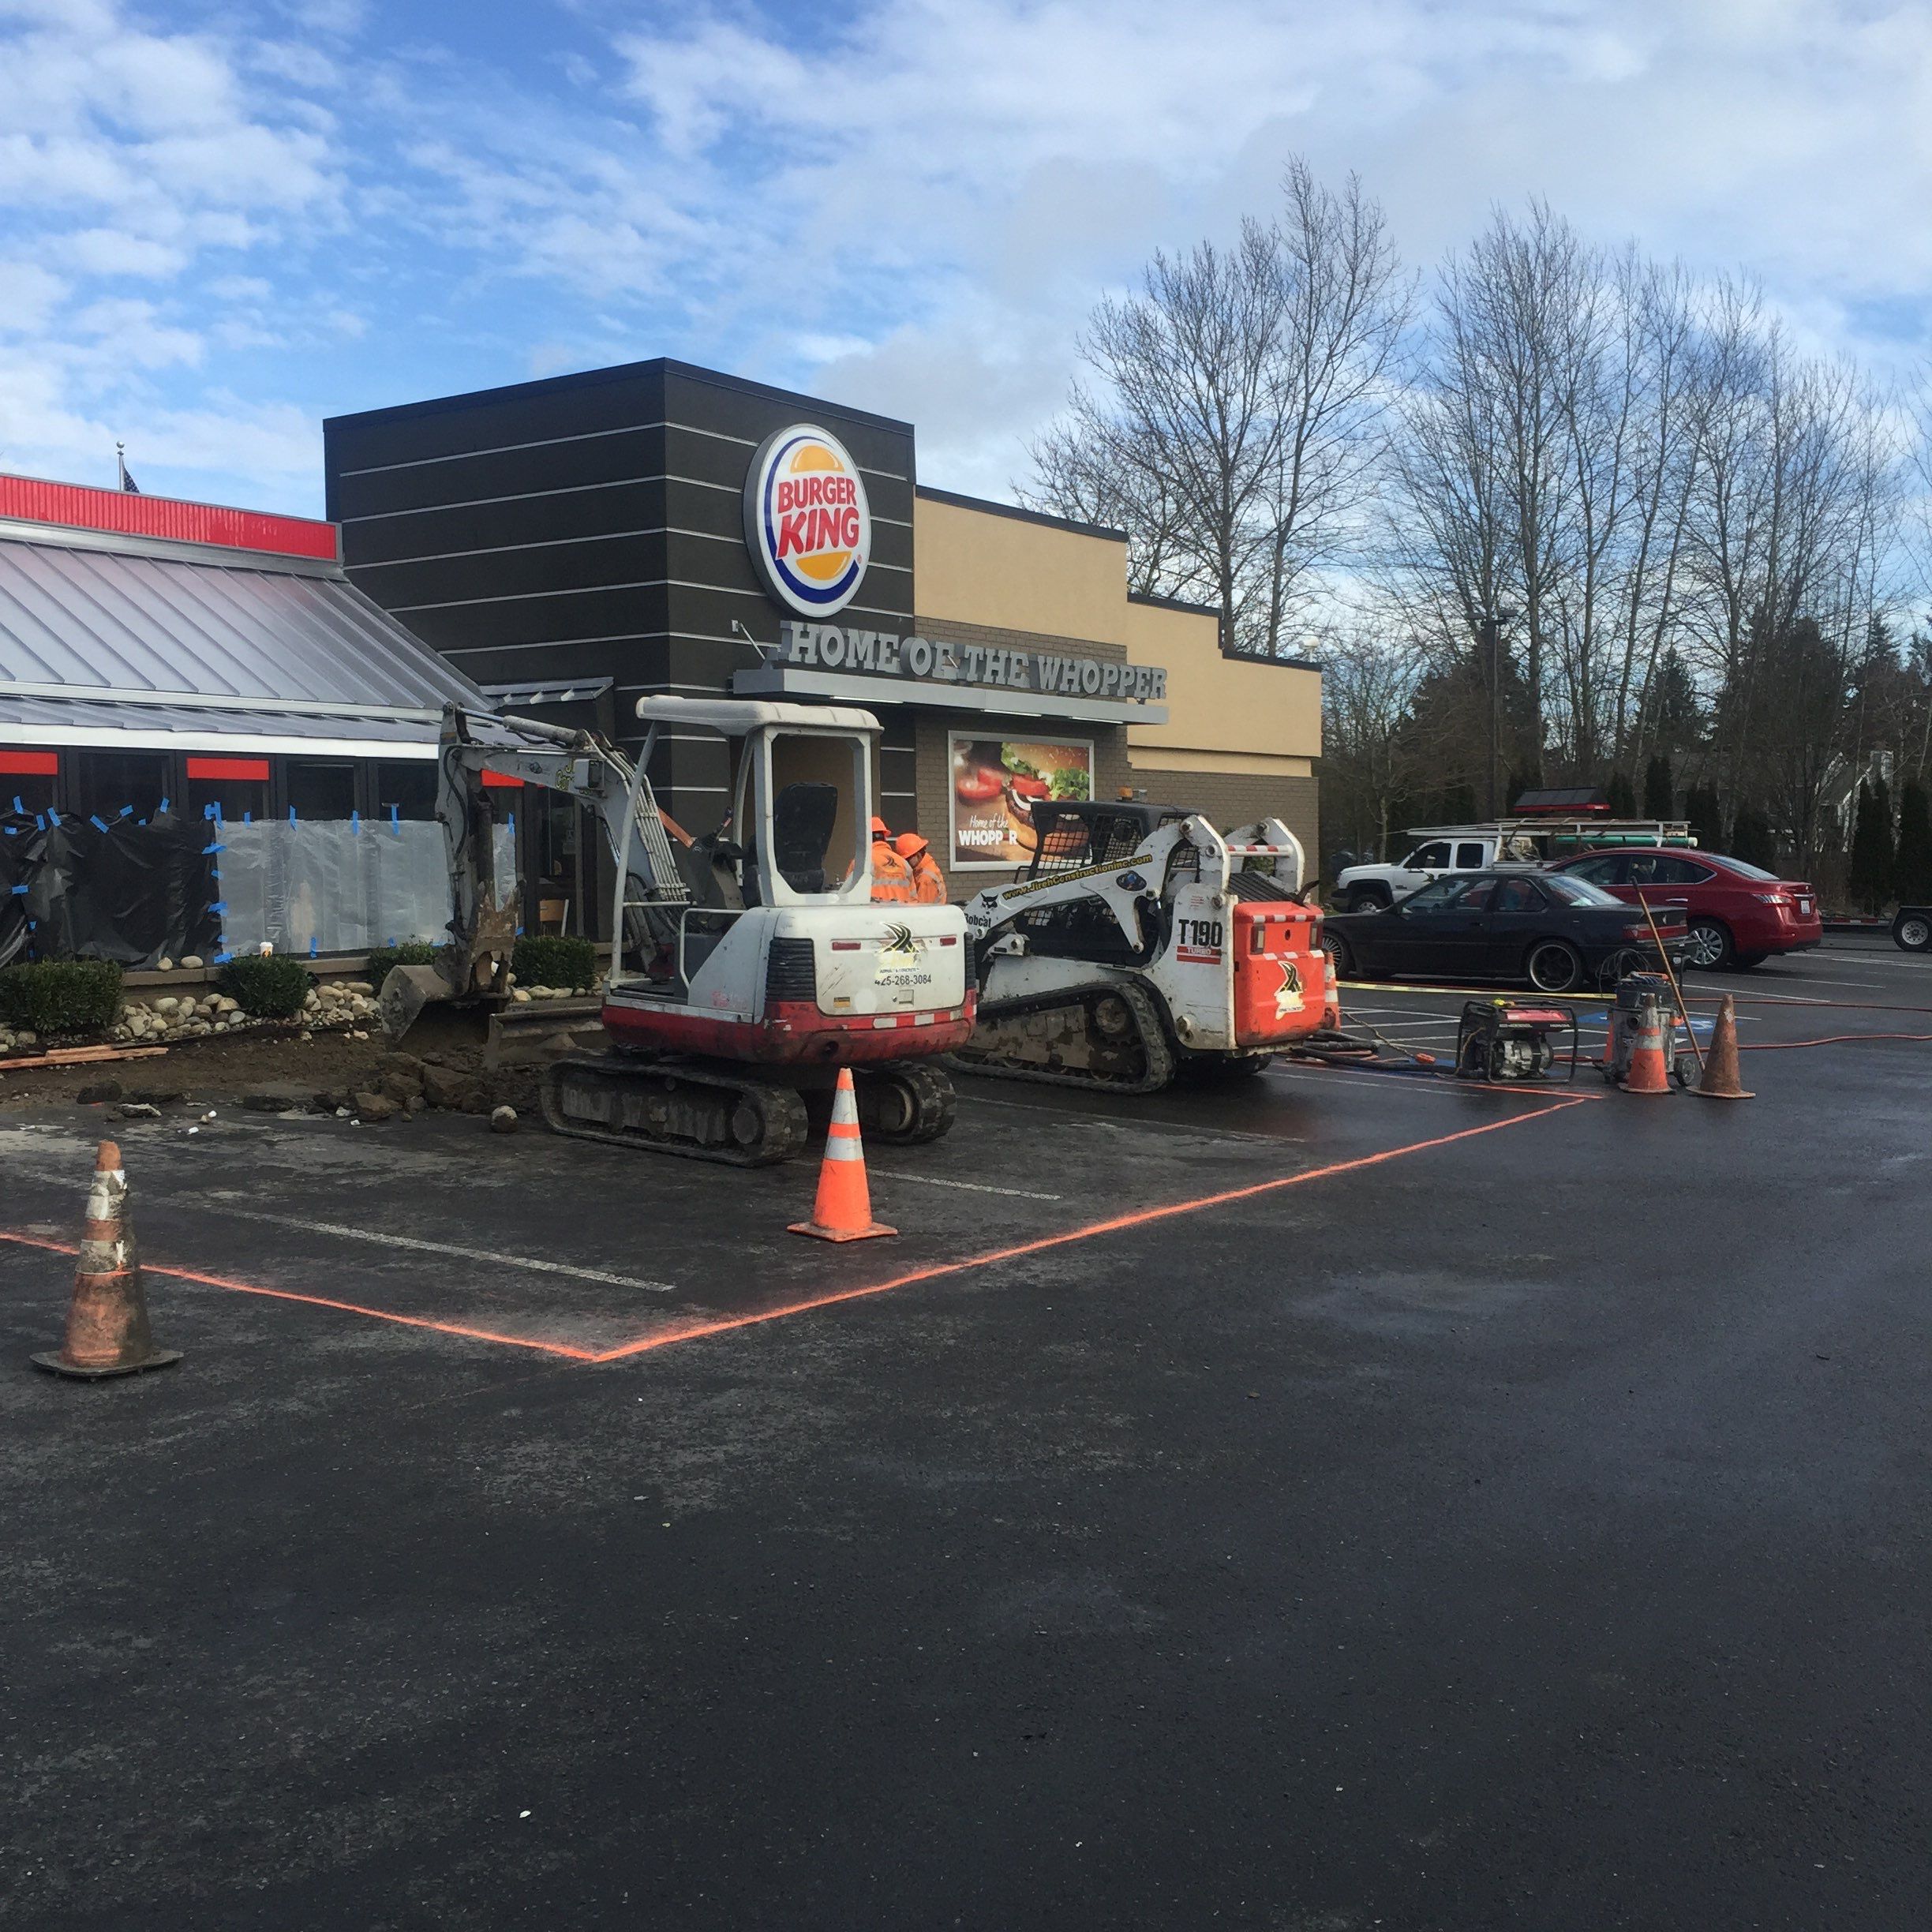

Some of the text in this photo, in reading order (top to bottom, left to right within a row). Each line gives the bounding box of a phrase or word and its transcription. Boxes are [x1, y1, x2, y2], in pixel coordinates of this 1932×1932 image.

[777, 476, 857, 515] BURGER
[777, 506, 859, 559] KING
[781, 620, 902, 673] HOME
[964, 645, 1031, 688] THE
[1033, 654, 1167, 699] WHOPPER
[969, 812, 1009, 829] Home of the
[958, 829, 1019, 846] WHOPPR
[1178, 919, 1222, 947] T190
[1186, 946, 1211, 956] TURBO
